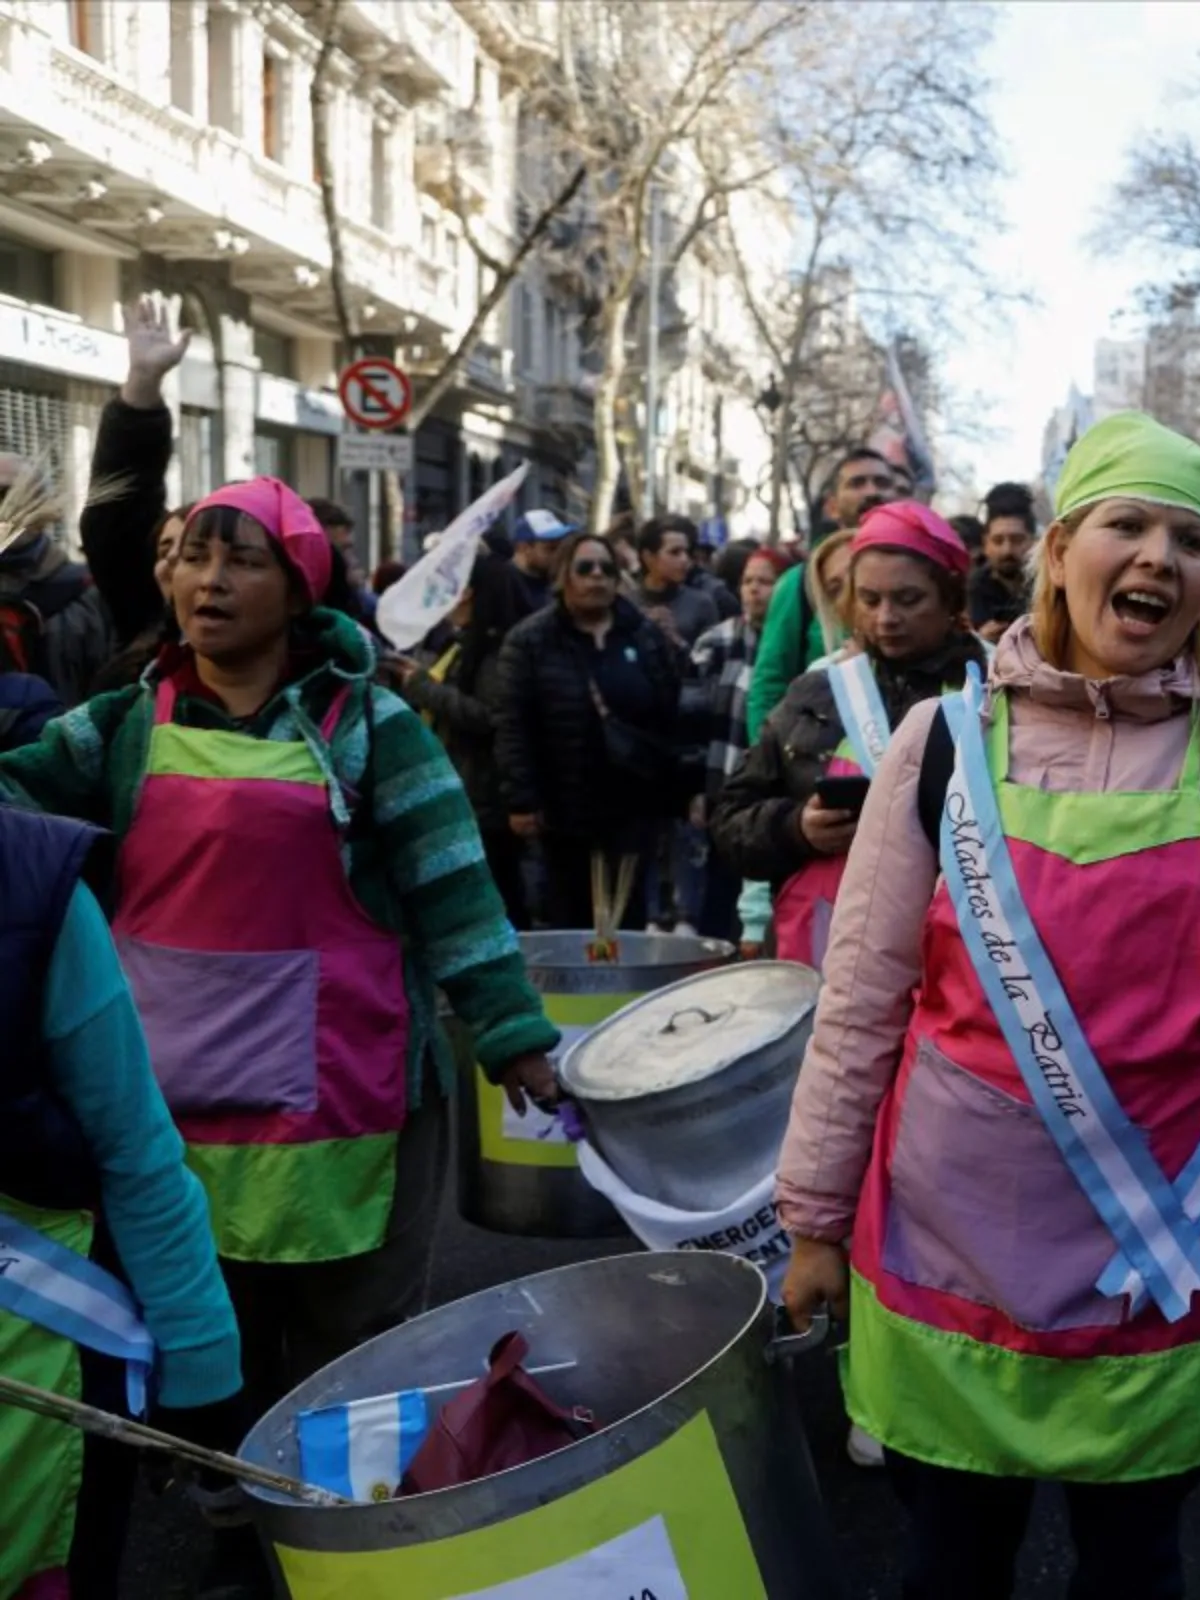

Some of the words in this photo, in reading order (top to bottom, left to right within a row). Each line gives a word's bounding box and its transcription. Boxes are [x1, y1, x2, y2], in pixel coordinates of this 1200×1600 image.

[946, 792, 994, 920] Madres
[981, 929, 1016, 964] de
[999, 973, 1032, 1002] la
[1023, 1009, 1087, 1119] Patria
